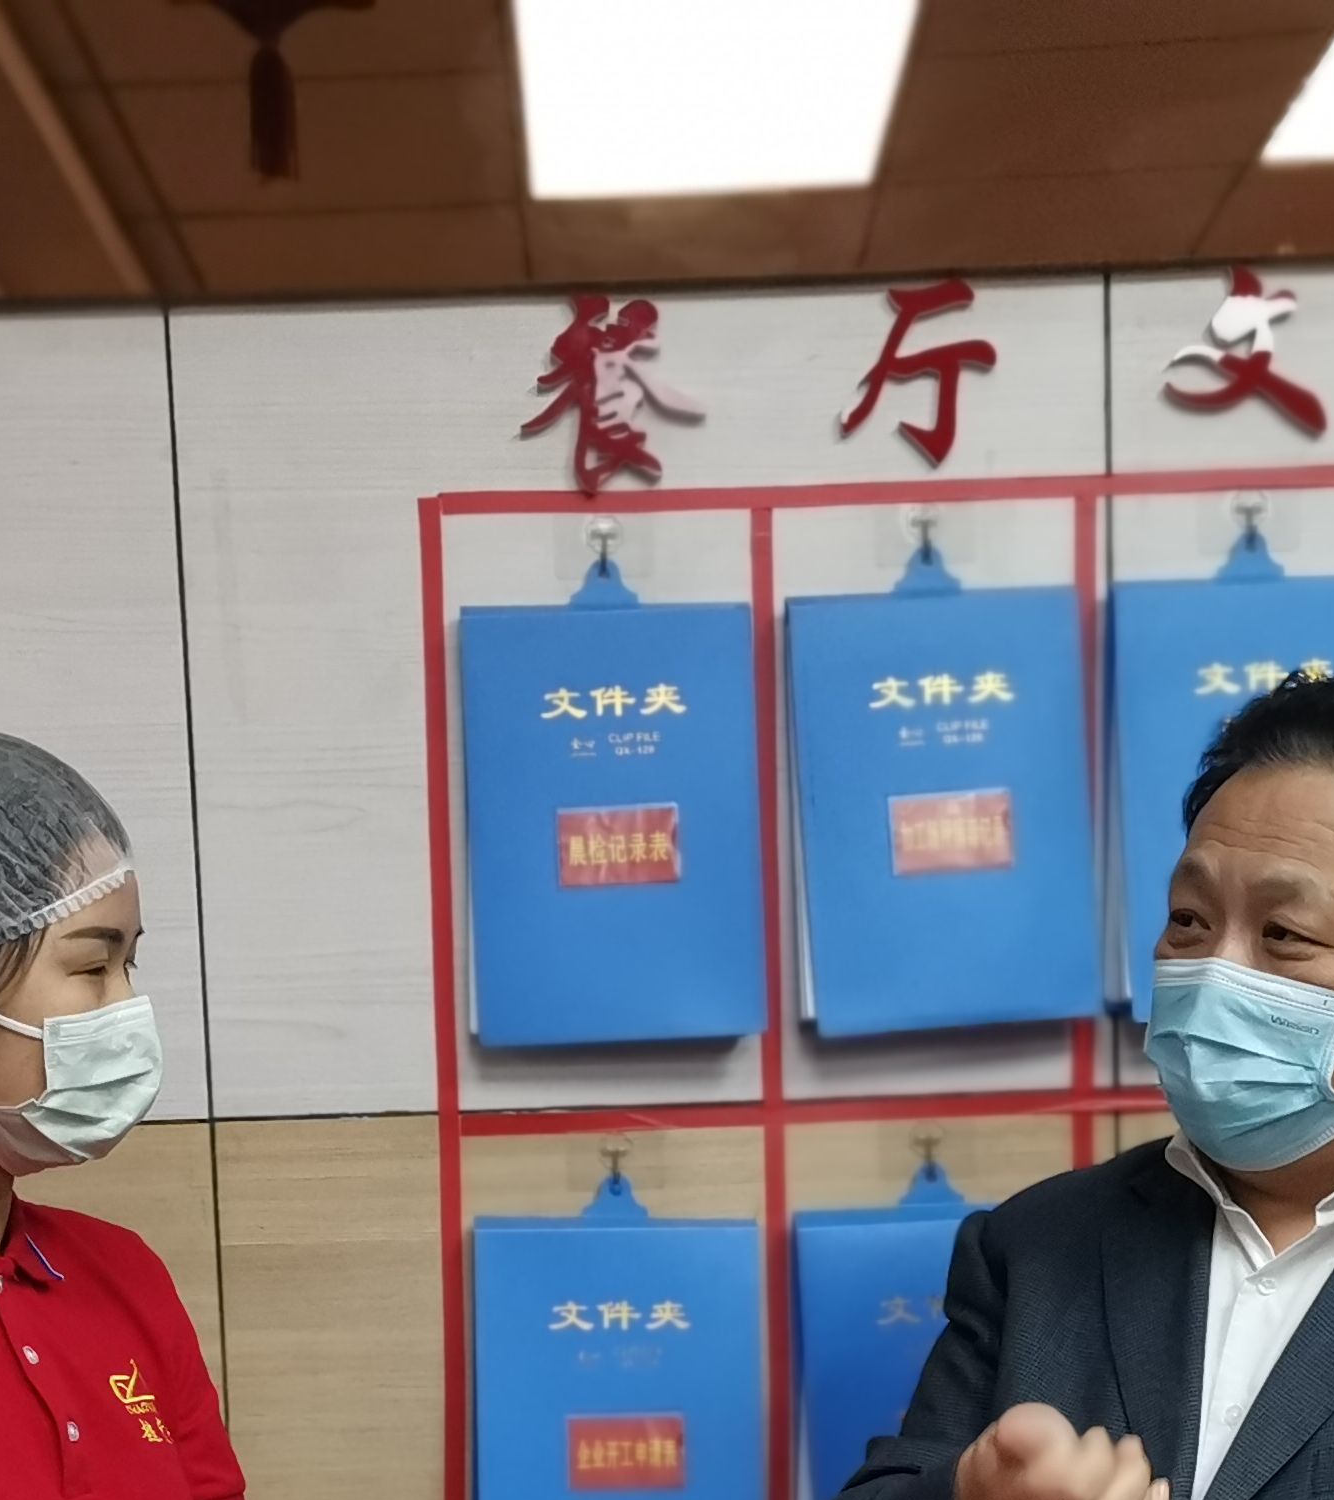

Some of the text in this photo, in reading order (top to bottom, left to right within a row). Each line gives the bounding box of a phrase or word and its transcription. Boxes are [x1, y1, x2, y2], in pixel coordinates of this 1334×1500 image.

[540, 684, 687, 719] 文件夹
[869, 671, 1014, 709] 文件夹
[568, 831, 669, 867] 晨检记录表
[548, 1300, 691, 1331] 文件夹
